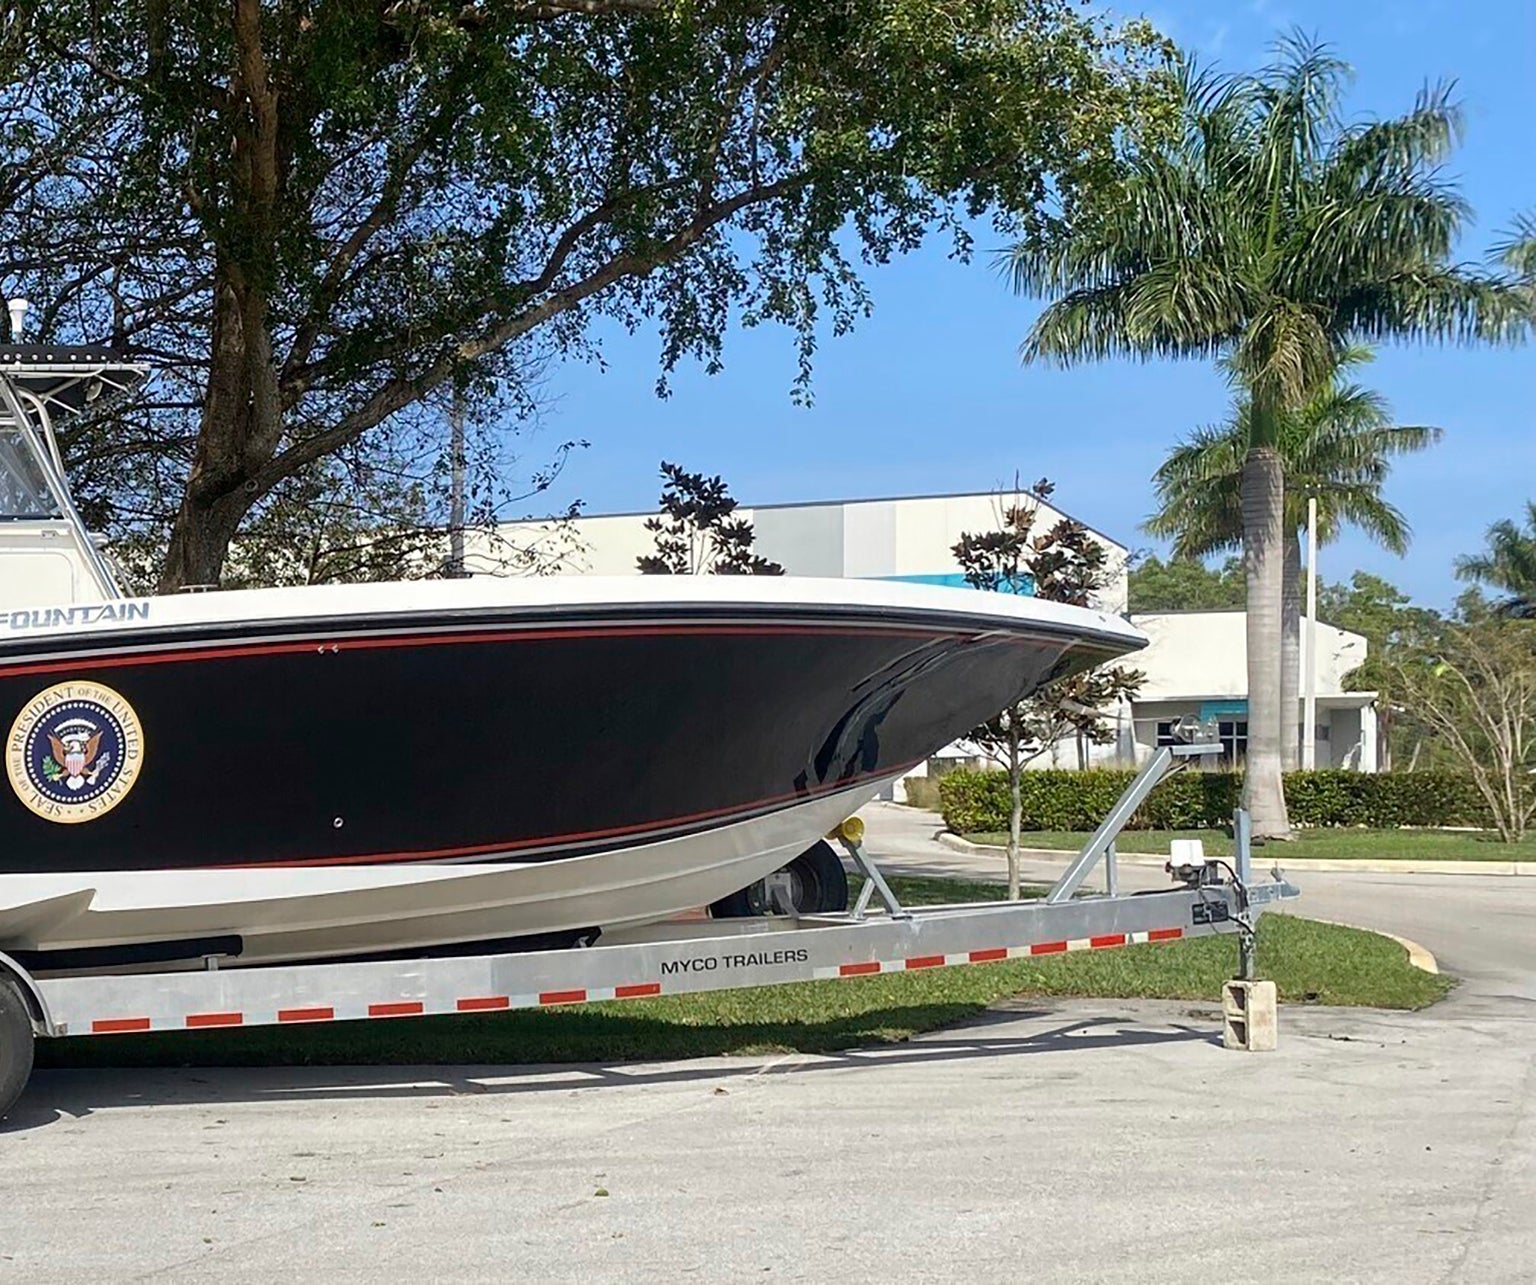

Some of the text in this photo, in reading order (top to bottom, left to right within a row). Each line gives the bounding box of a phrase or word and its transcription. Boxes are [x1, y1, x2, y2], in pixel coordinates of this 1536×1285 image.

[77, 688, 91, 697] OF
[93, 690, 112, 702] THE
[11, 686, 74, 752] PRESIDENT
[111, 701, 139, 760] UNITED
[88, 767, 133, 813] STATES
[29, 792, 64, 816] SEAL
[661, 949, 809, 975] MYCO TRAILERS
